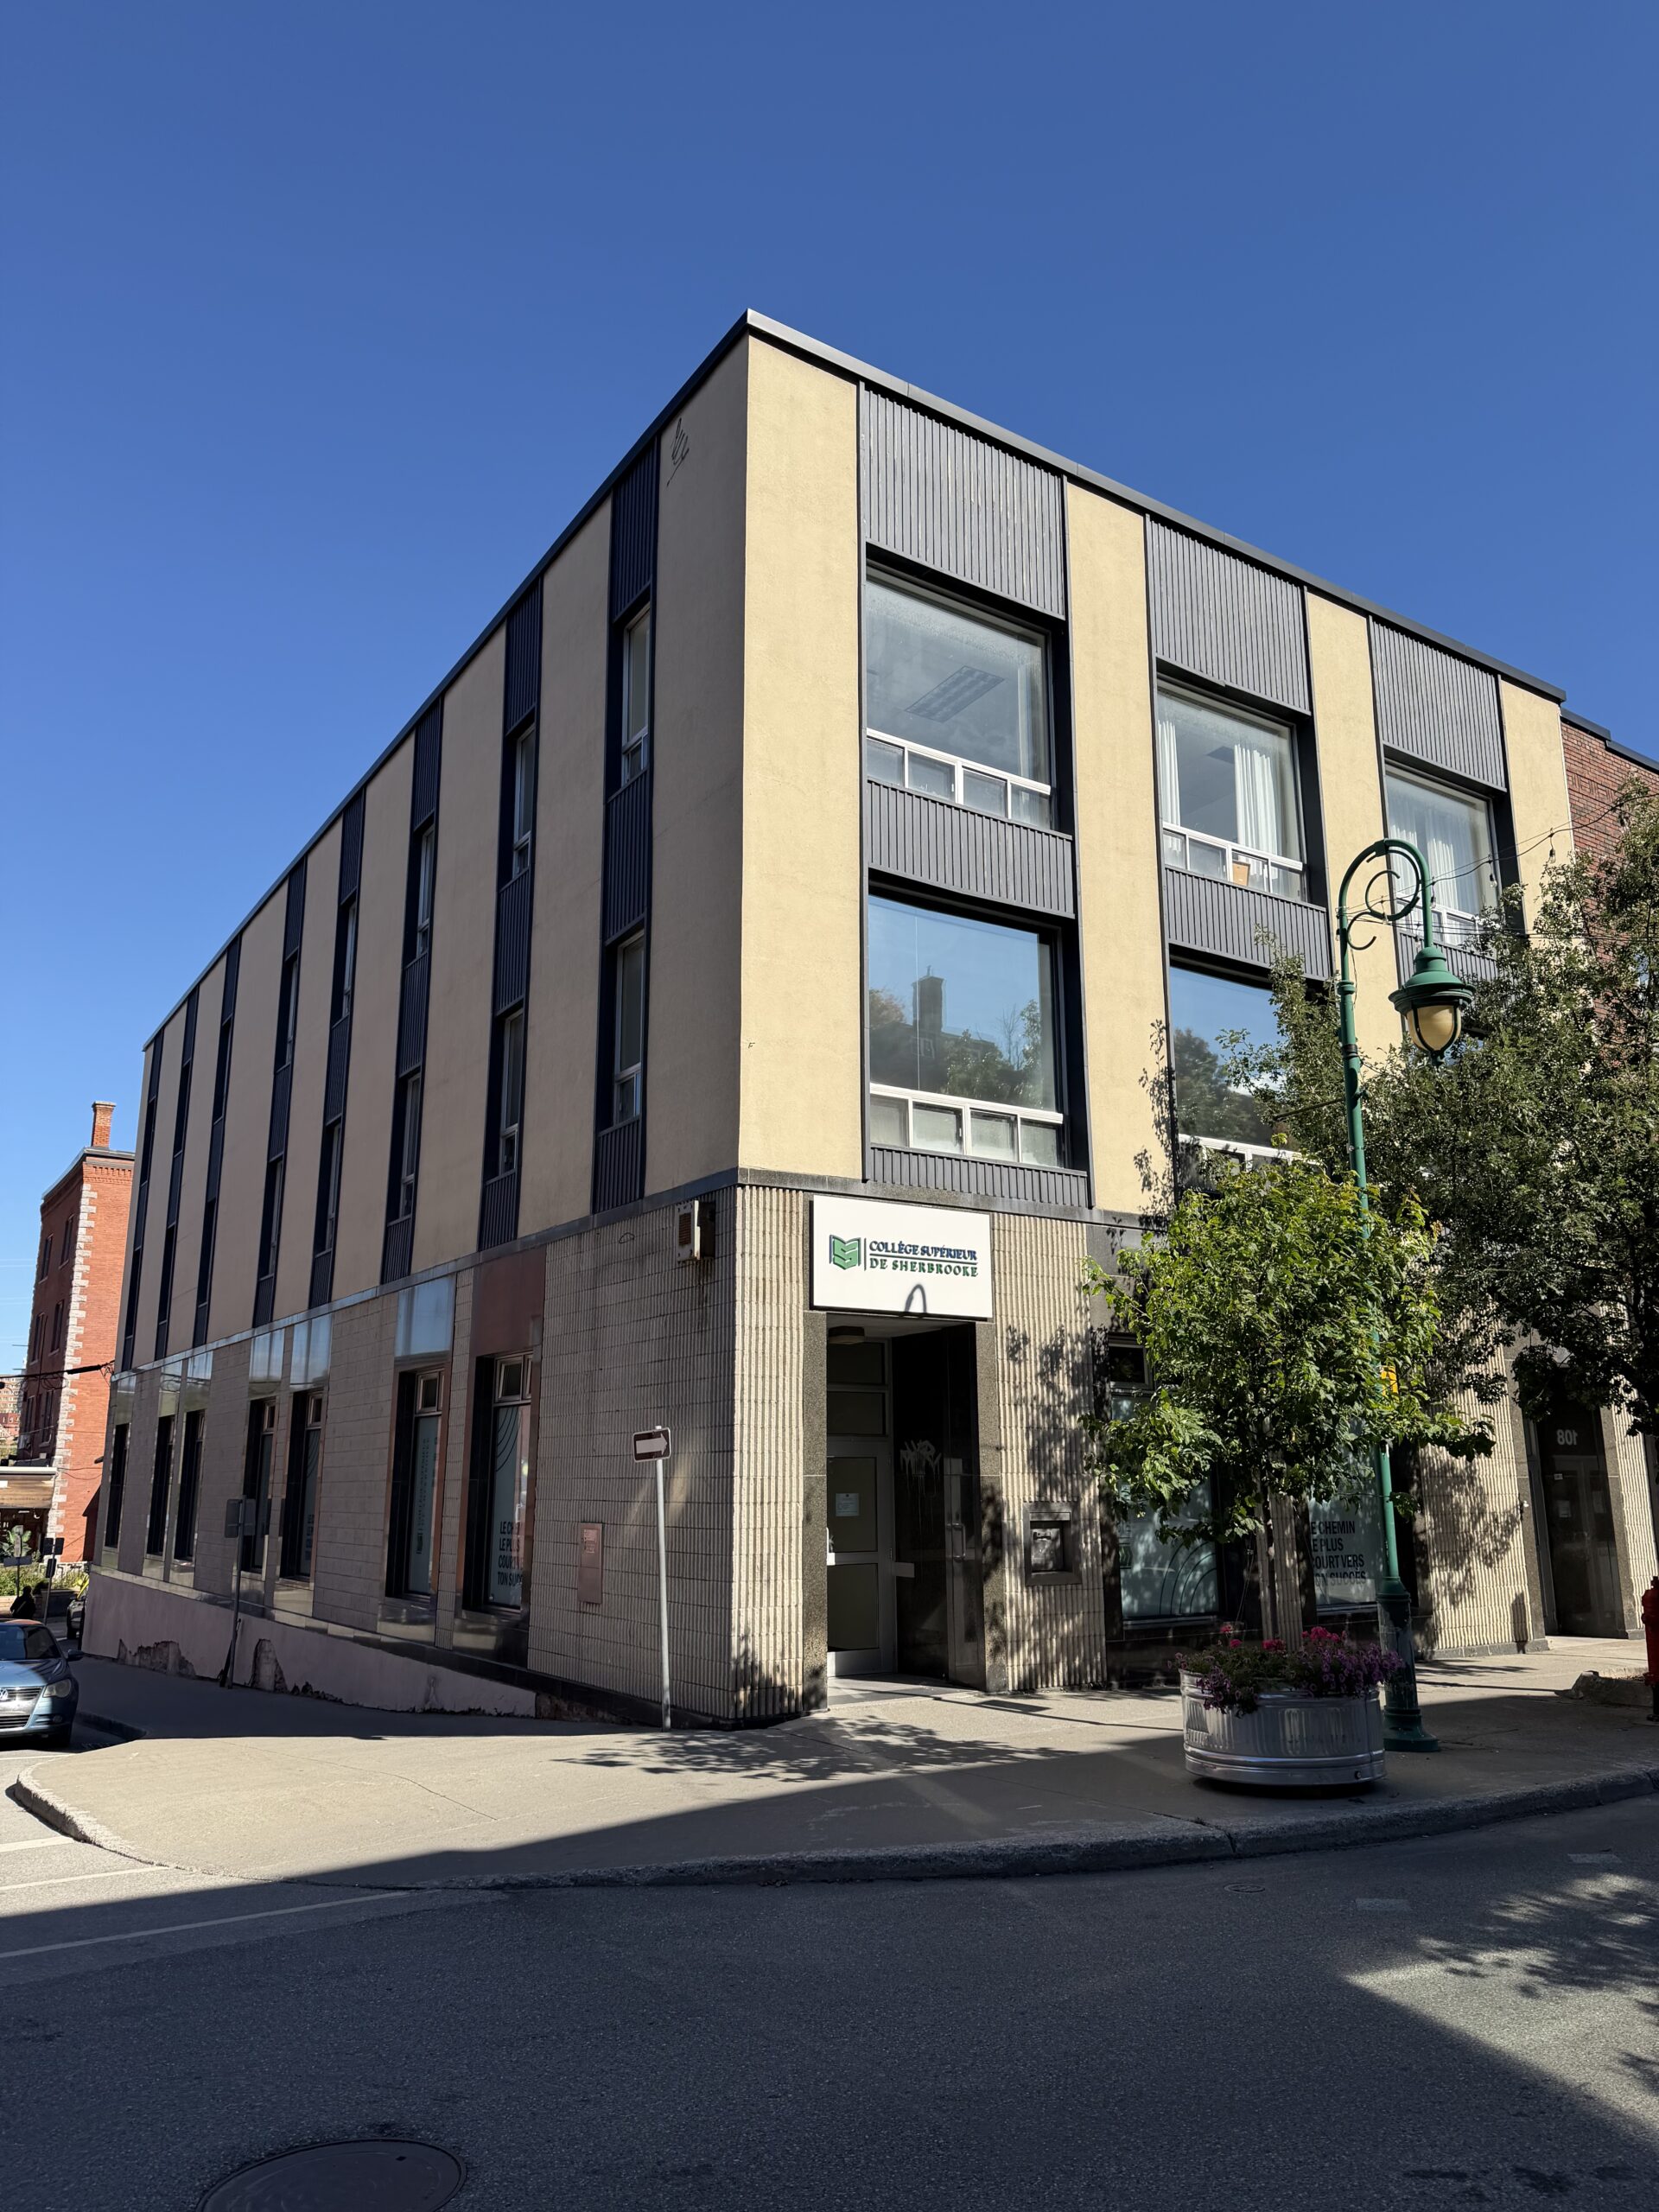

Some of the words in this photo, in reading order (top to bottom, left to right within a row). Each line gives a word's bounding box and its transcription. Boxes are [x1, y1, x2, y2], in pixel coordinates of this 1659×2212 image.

[920, 1244, 977, 1261] SUPÉRIEUR
[869, 1257, 888, 1269] DE
[892, 1260, 979, 1277] SHERBROOKE
[500, 1521, 506, 1535] LE
[1319, 1521, 1356, 1535] CHEMIN
[499, 1538, 505, 1552] LE
[1319, 1538, 1344, 1553] PLUS
[1340, 1554, 1365, 1568] VERS
[498, 1572, 508, 1586] TON
[1313, 1573, 1328, 1586] ON
